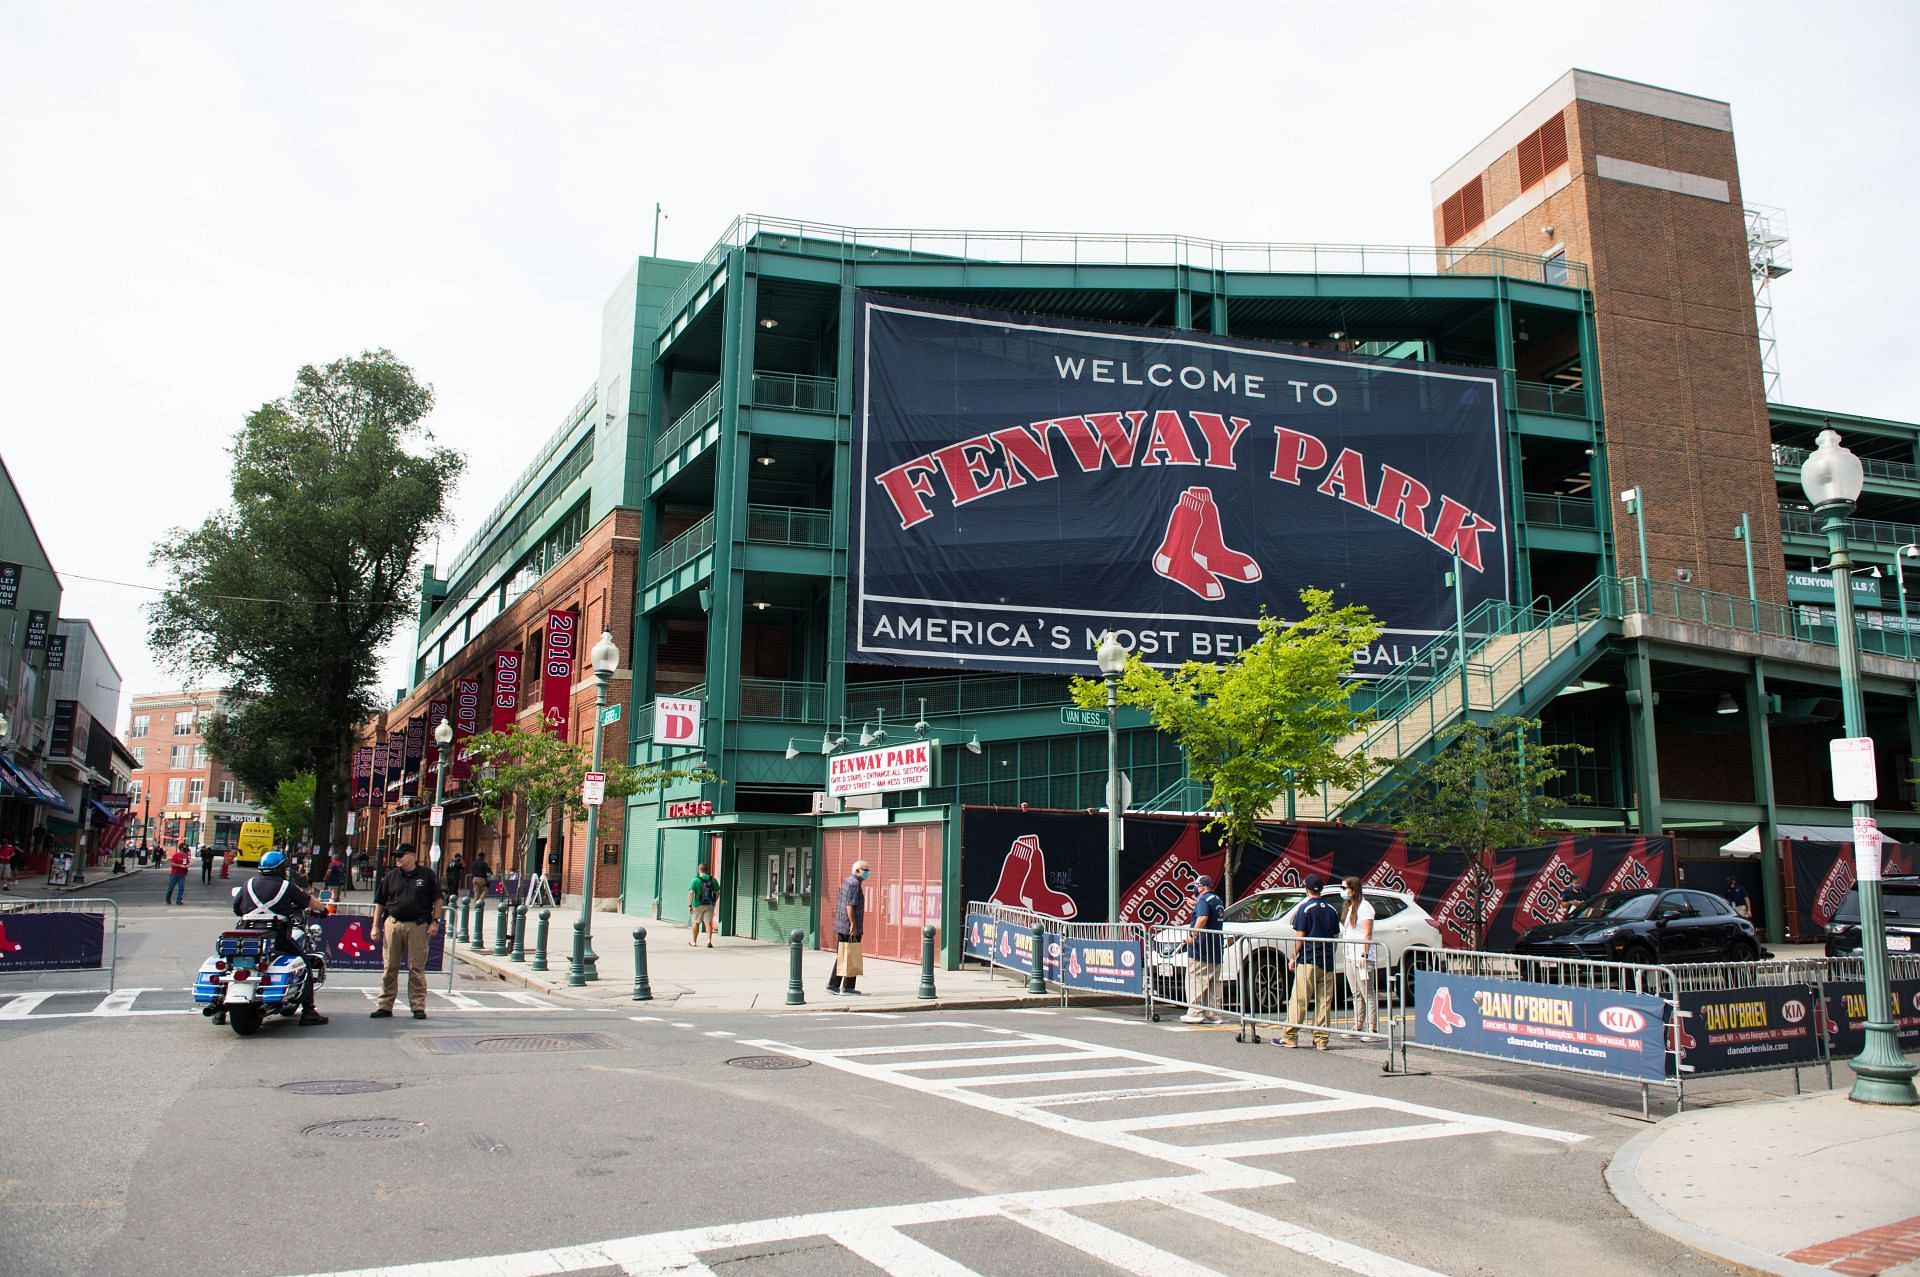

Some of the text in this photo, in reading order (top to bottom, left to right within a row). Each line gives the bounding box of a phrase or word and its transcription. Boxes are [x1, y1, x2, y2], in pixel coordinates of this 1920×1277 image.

[1054, 355, 1338, 407] WELCOME TO
[874, 410, 1497, 573] FENWAY PARK
[1795, 575, 1834, 588] KENYON
[548, 614, 573, 678] 2018
[872, 614, 1072, 650] AMERICA'S
[1086, 627, 1180, 655] MOST
[1352, 643, 1462, 668] BALLPA
[496, 655, 518, 709] 2013
[458, 681, 479, 734] 2007
[660, 702, 697, 712] GATE
[1065, 710, 1080, 722] VAN
[1082, 711, 1100, 725] NESS
[406, 718, 424, 758] 1986
[429, 702, 448, 748] 20
[664, 714, 694, 740] D
[374, 744, 389, 776] 1967
[388, 733, 404, 768] 1975
[832, 746, 927, 775] FENWAY PARK
[831, 776, 841, 784] GATE
[866, 769, 891, 780] ENTRANCE
[891, 768, 901, 776] ALL
[903, 765, 929, 775] SECTIONS
[834, 783, 851, 792] JERSEY
[853, 781, 871, 789] STREET
[887, 778, 901, 786] NESS
[902, 775, 923, 784] STREET
[231, 814, 256, 822] BOSTON
[668, 801, 713, 818] TICKETS
[1855, 826, 1868, 834] NO
[1260, 857, 1291, 889] SERIES
[1365, 860, 1391, 888] ERIES
[1523, 881, 1542, 913] WORLD
[1539, 854, 1561, 883] SERIES
[1614, 855, 1634, 882] SERIES
[1621, 859, 1649, 890] 04
[1817, 858, 1843, 906] WORLD SERIES
[1119, 854, 1179, 924] WORLD SERIES
[1131, 861, 1200, 938] 903
[1530, 862, 1574, 925] 1918
[1822, 860, 1854, 918] 2007
[1437, 892, 1460, 924] WORLD
[1482, 991, 1574, 1027] DAN O'BRIEN
[1605, 1011, 1638, 1028] KIA
[1706, 1001, 1768, 1031] DAN O'BRIEN
[1784, 1004, 1803, 1018] KIA
[1847, 994, 1866, 1018] DAN
[1482, 1019, 1640, 1049] Concord, NH North Hampton, NH Norwood, MA
[1507, 1036, 1607, 1058] danobrienkia.com
[1727, 1043, 1789, 1056] danobrienkia.com
